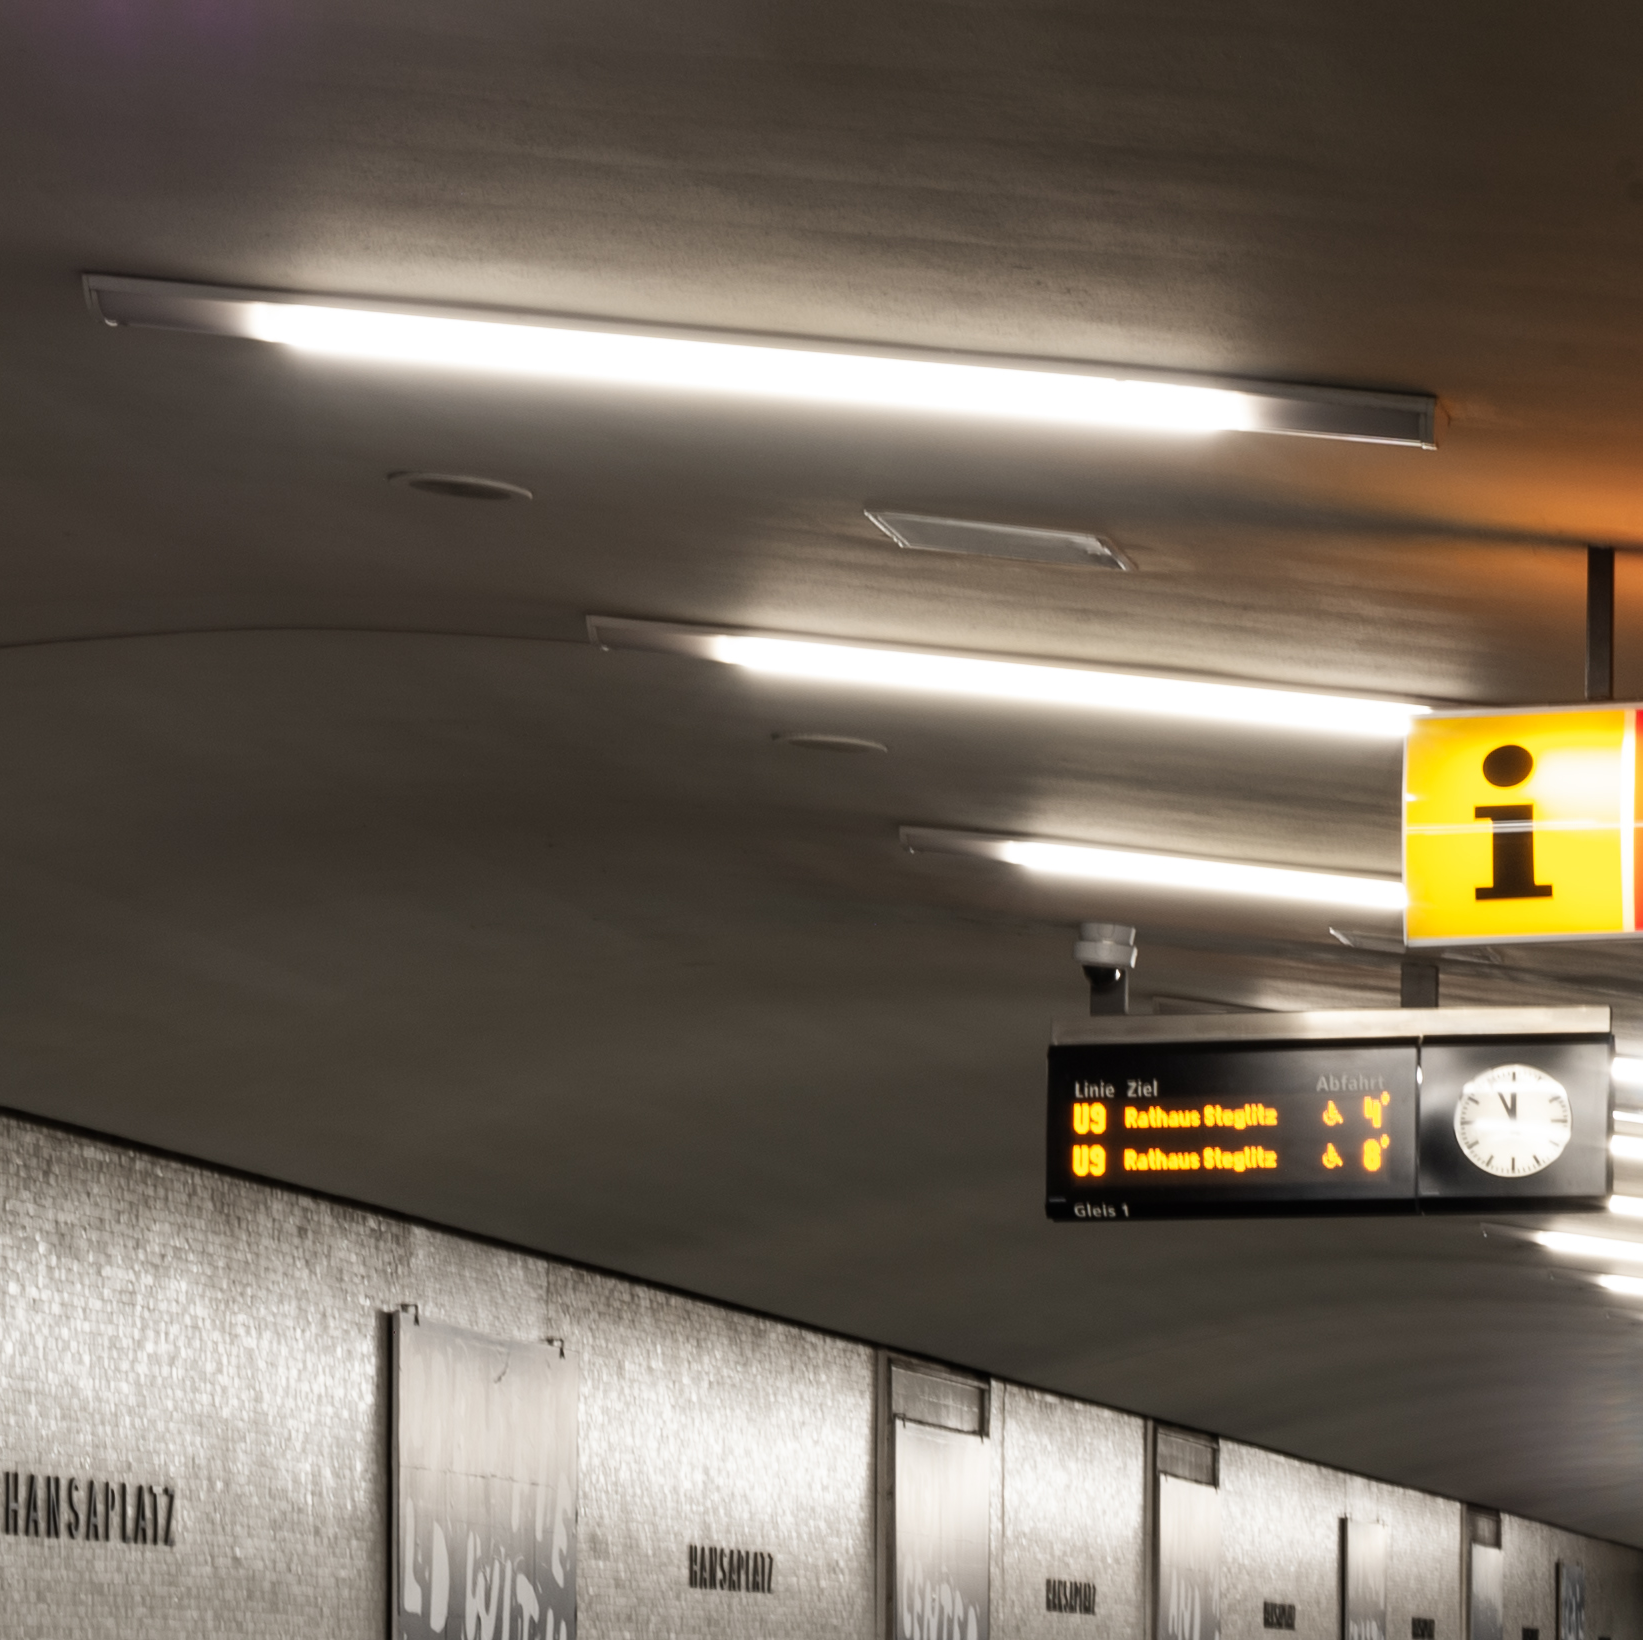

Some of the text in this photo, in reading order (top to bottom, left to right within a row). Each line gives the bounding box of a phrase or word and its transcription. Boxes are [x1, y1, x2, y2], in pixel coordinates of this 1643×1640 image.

[1074, 1071, 1385, 1099] Linie Ziel Abfahrt
[1072, 1102, 1107, 1135] U9
[1123, 1105, 1201, 1129] Rathaus
[1203, 1103, 1278, 1131] Steglitz
[1072, 1144, 1107, 1177] U9
[1123, 1147, 1201, 1171] Rathaus
[1202, 1145, 1278, 1173] Steglitz
[1073, 1202, 1130, 1219] Gleis 1
[3, 1470, 176, 1548] HANSAPLATZ
